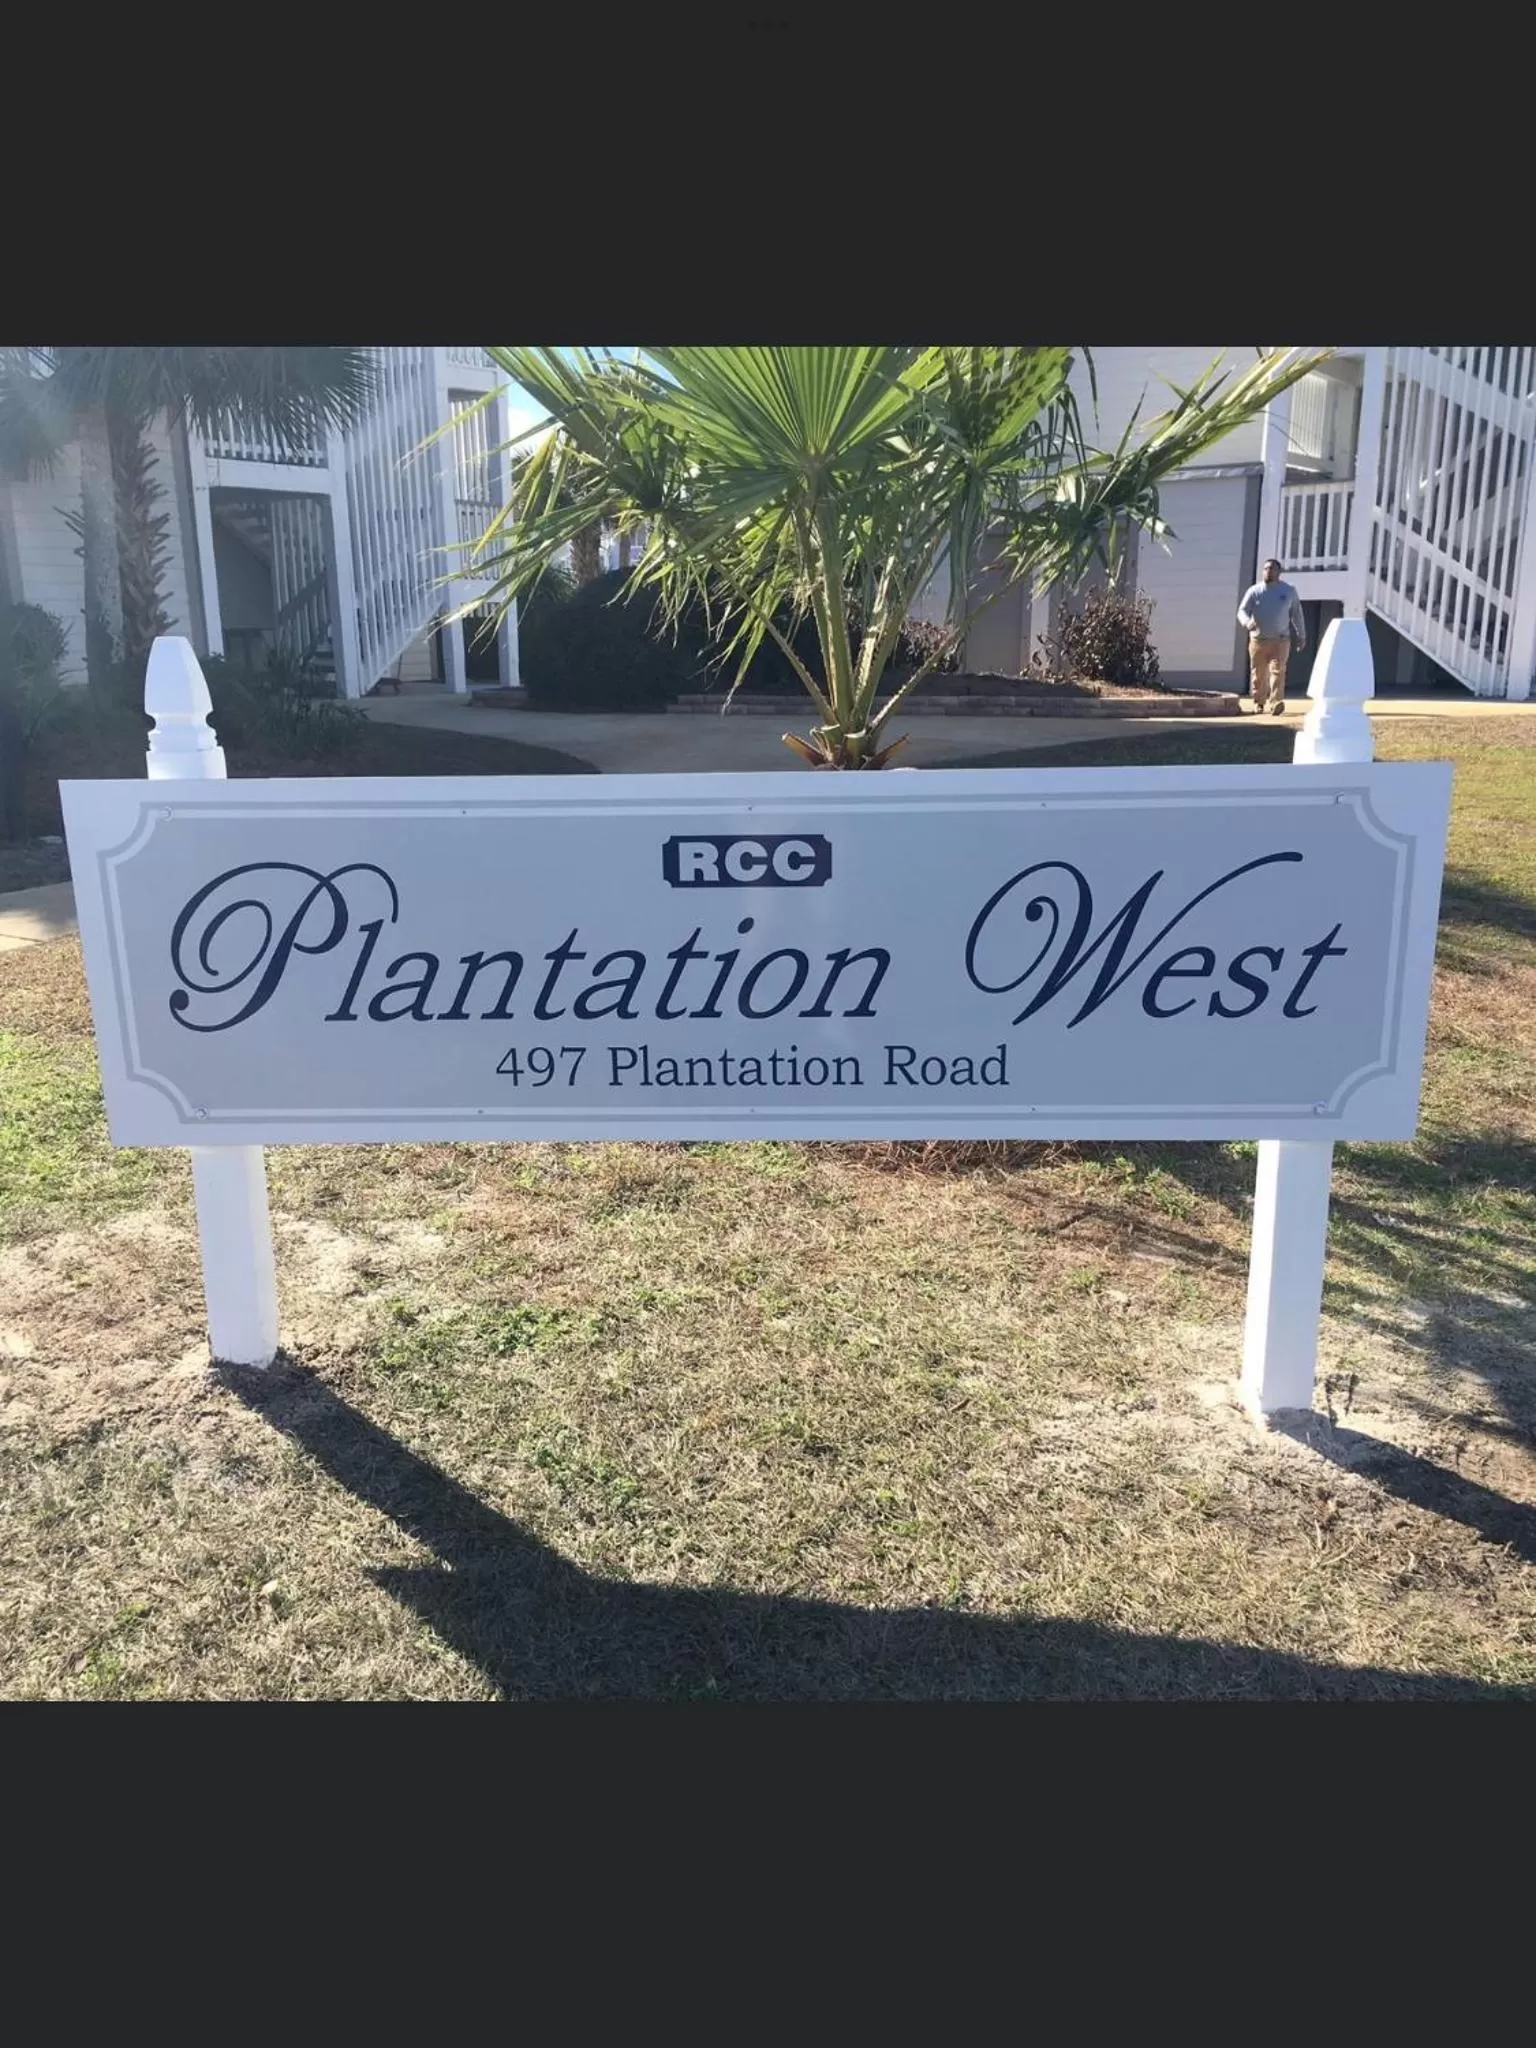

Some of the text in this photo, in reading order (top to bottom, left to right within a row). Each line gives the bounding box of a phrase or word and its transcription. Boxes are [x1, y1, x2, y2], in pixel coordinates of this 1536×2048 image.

[678, 840, 816, 882] RCC
[168, 851, 1348, 1033] Plantation West
[495, 1042, 1011, 1088] 497 Plantation Road
